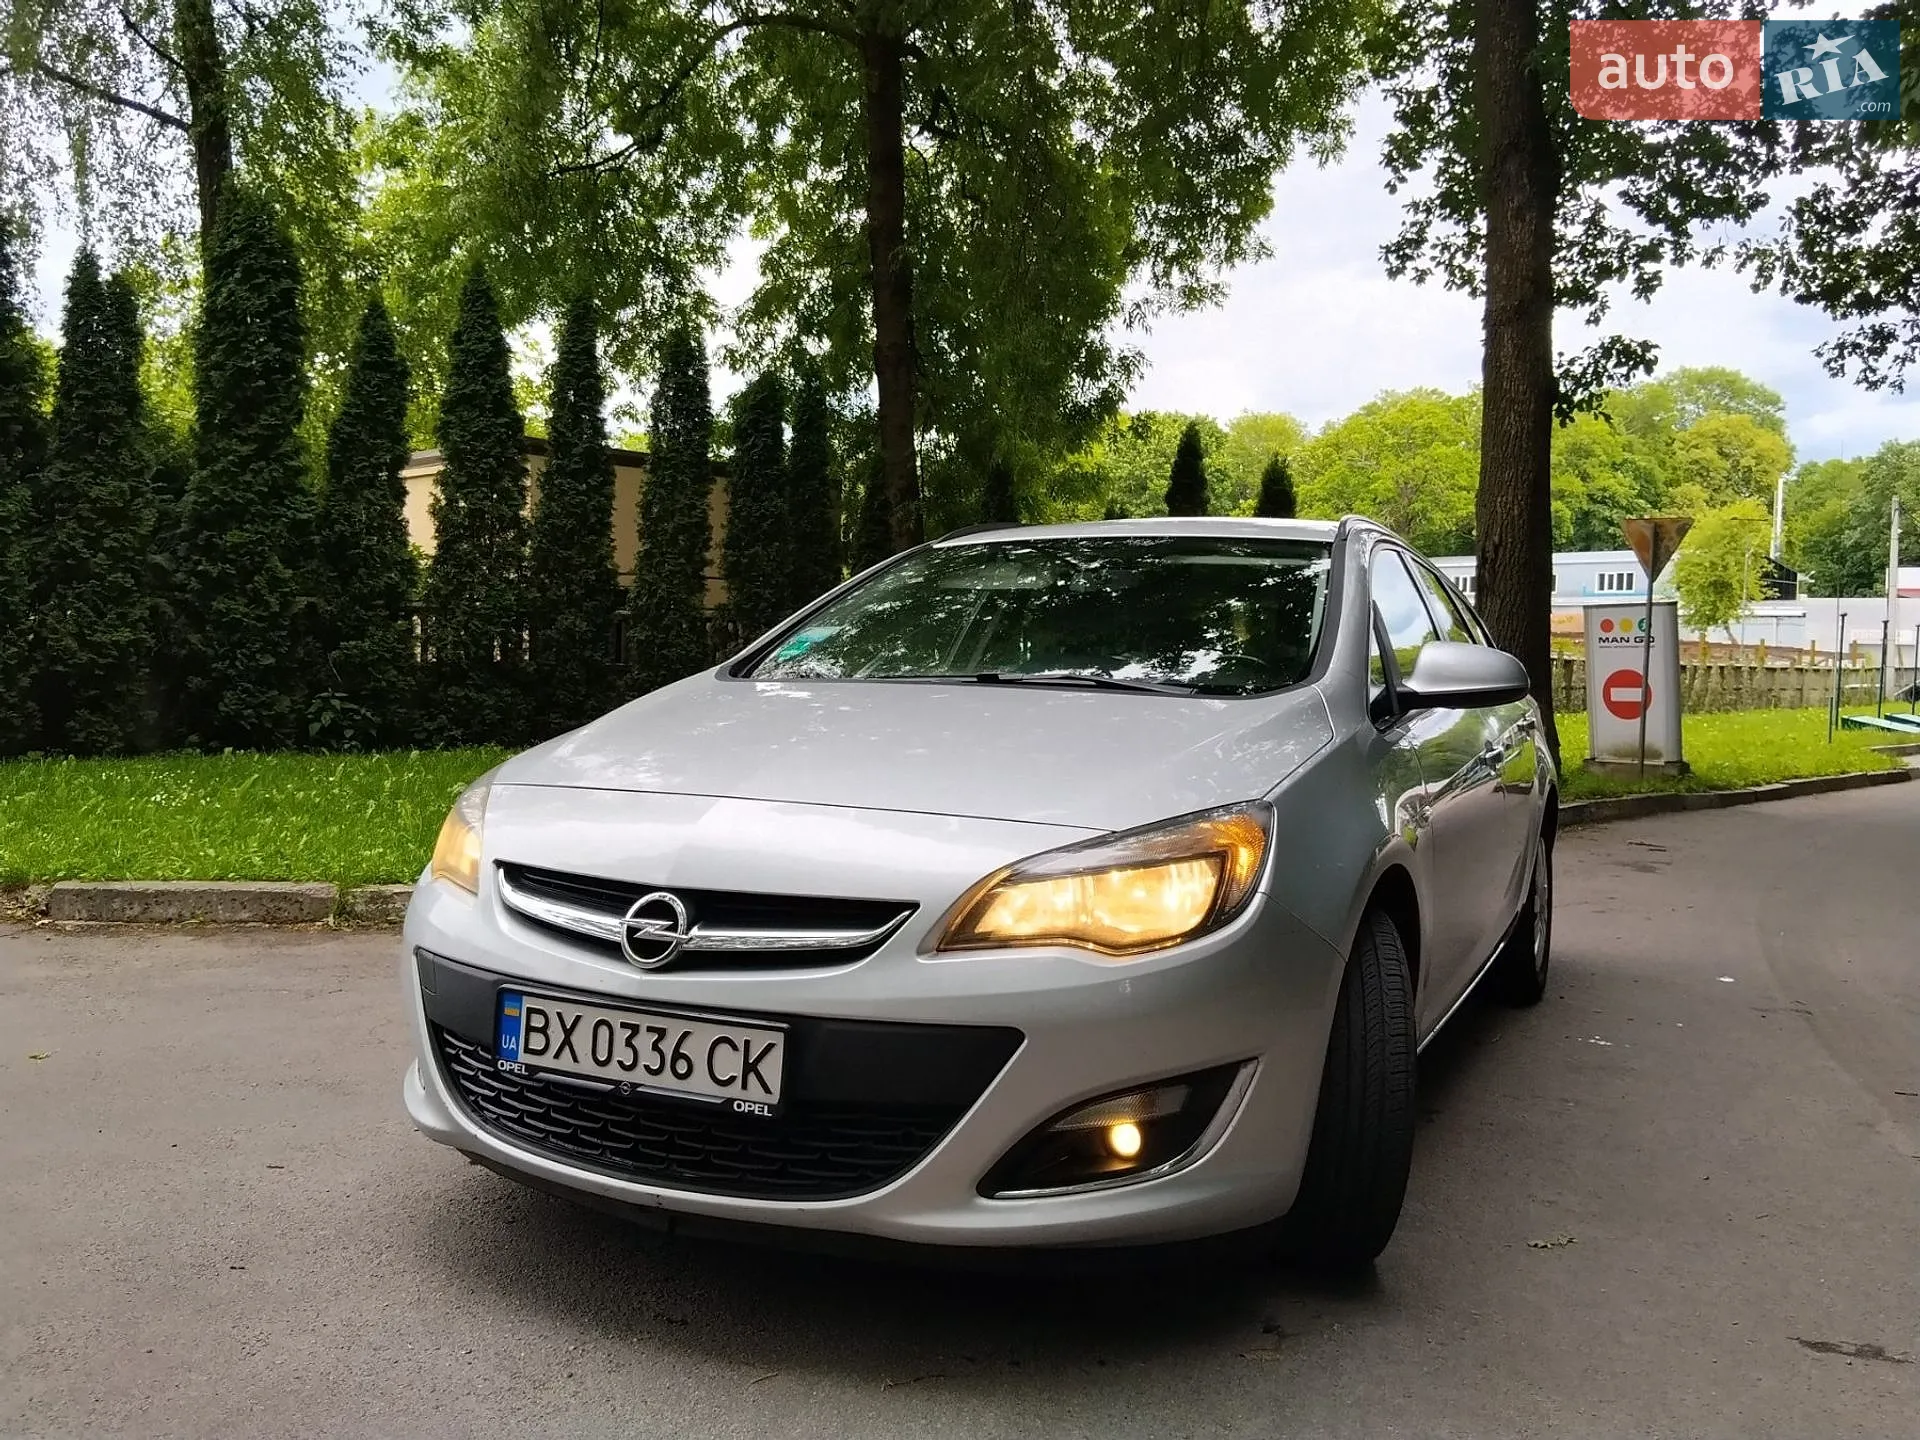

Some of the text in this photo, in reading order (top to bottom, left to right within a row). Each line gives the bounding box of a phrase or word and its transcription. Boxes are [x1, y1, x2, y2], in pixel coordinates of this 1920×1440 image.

[502, 1034, 517, 1051] UA
[523, 1006, 776, 1094] BX 0336 CK
[497, 1060, 529, 1075] OPEL
[733, 1100, 772, 1116] OPEL
